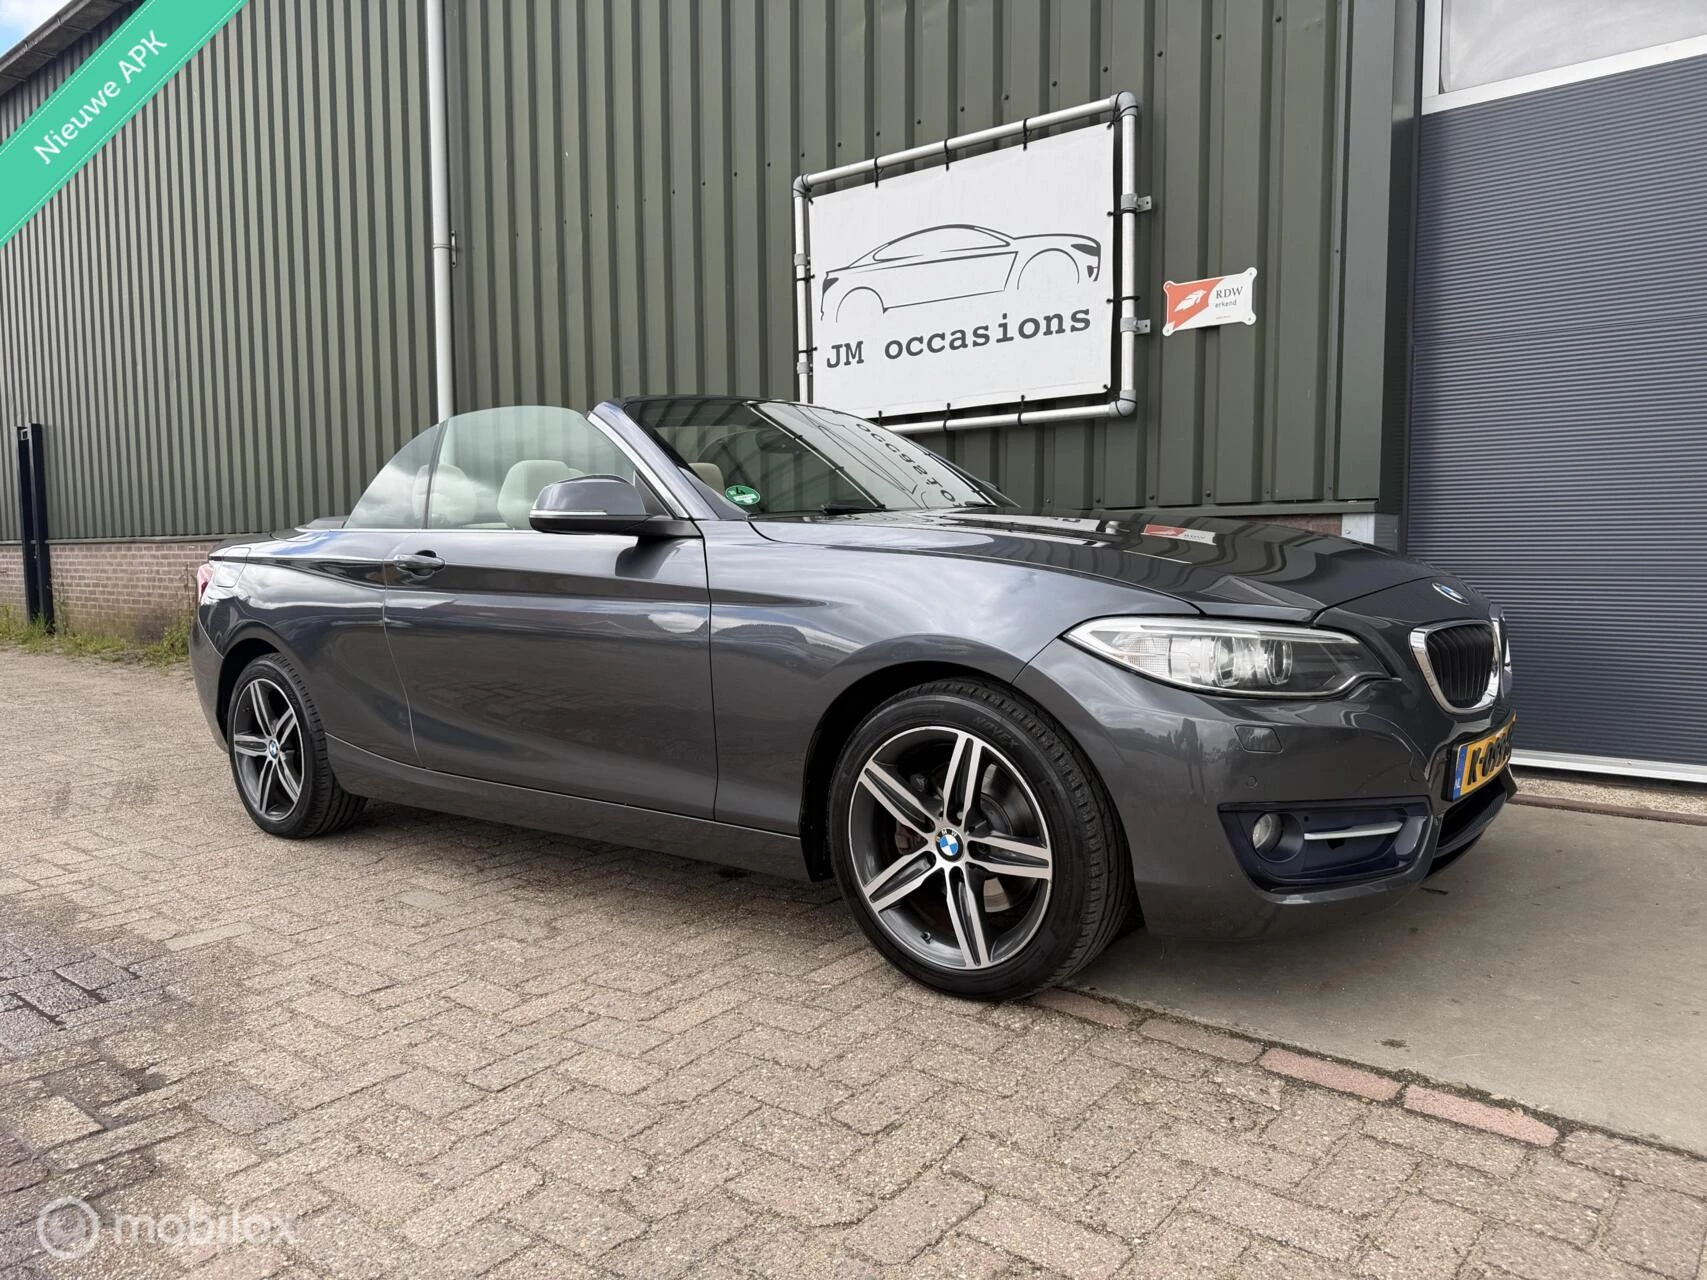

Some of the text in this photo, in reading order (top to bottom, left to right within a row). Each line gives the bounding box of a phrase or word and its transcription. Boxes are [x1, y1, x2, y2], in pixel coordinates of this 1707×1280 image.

[1216, 286, 1243, 299] RDW
[1215, 300, 1237, 308] erkend
[826, 308, 1091, 368] JM occasions
